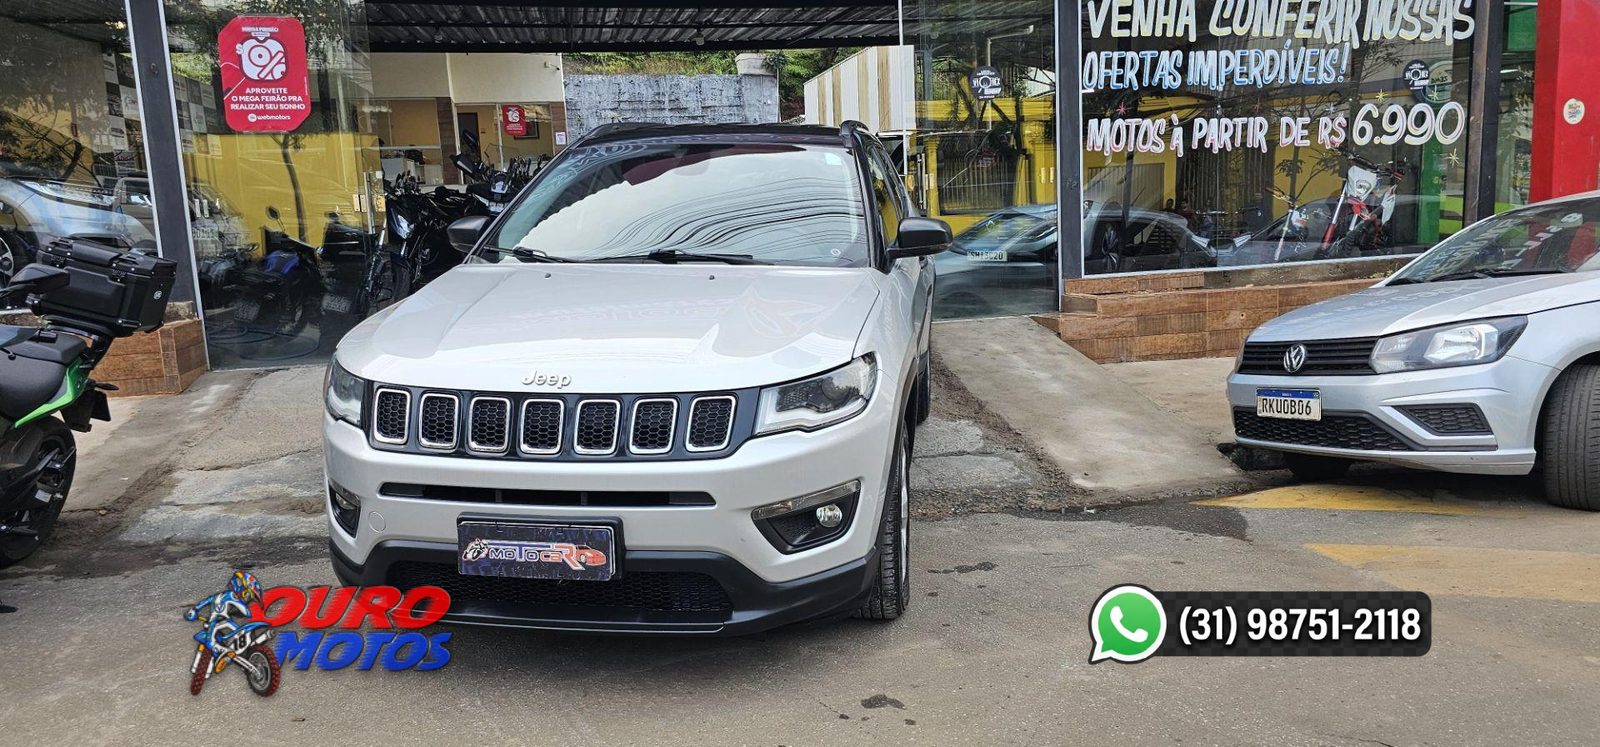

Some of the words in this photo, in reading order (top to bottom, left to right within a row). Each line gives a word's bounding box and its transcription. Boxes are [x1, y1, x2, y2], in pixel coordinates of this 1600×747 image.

[1087, 0, 1197, 43] VENHA
[1208, 0, 1362, 49] CONFERIR
[1362, 0, 1476, 46] NOSSAS
[1082, 50, 1184, 90] OFERTAS
[1186, 39, 1350, 91] IMPERDÍVEIS!
[261, 94, 287, 102] FEIRÃO
[1087, 117, 1167, 156] MOTOS
[1191, 116, 1268, 154] PARTIR
[1279, 116, 1310, 147] DE
[1317, 112, 1348, 150] R$
[1352, 101, 1466, 146] 6.990
[521, 370, 572, 389] Jeep
